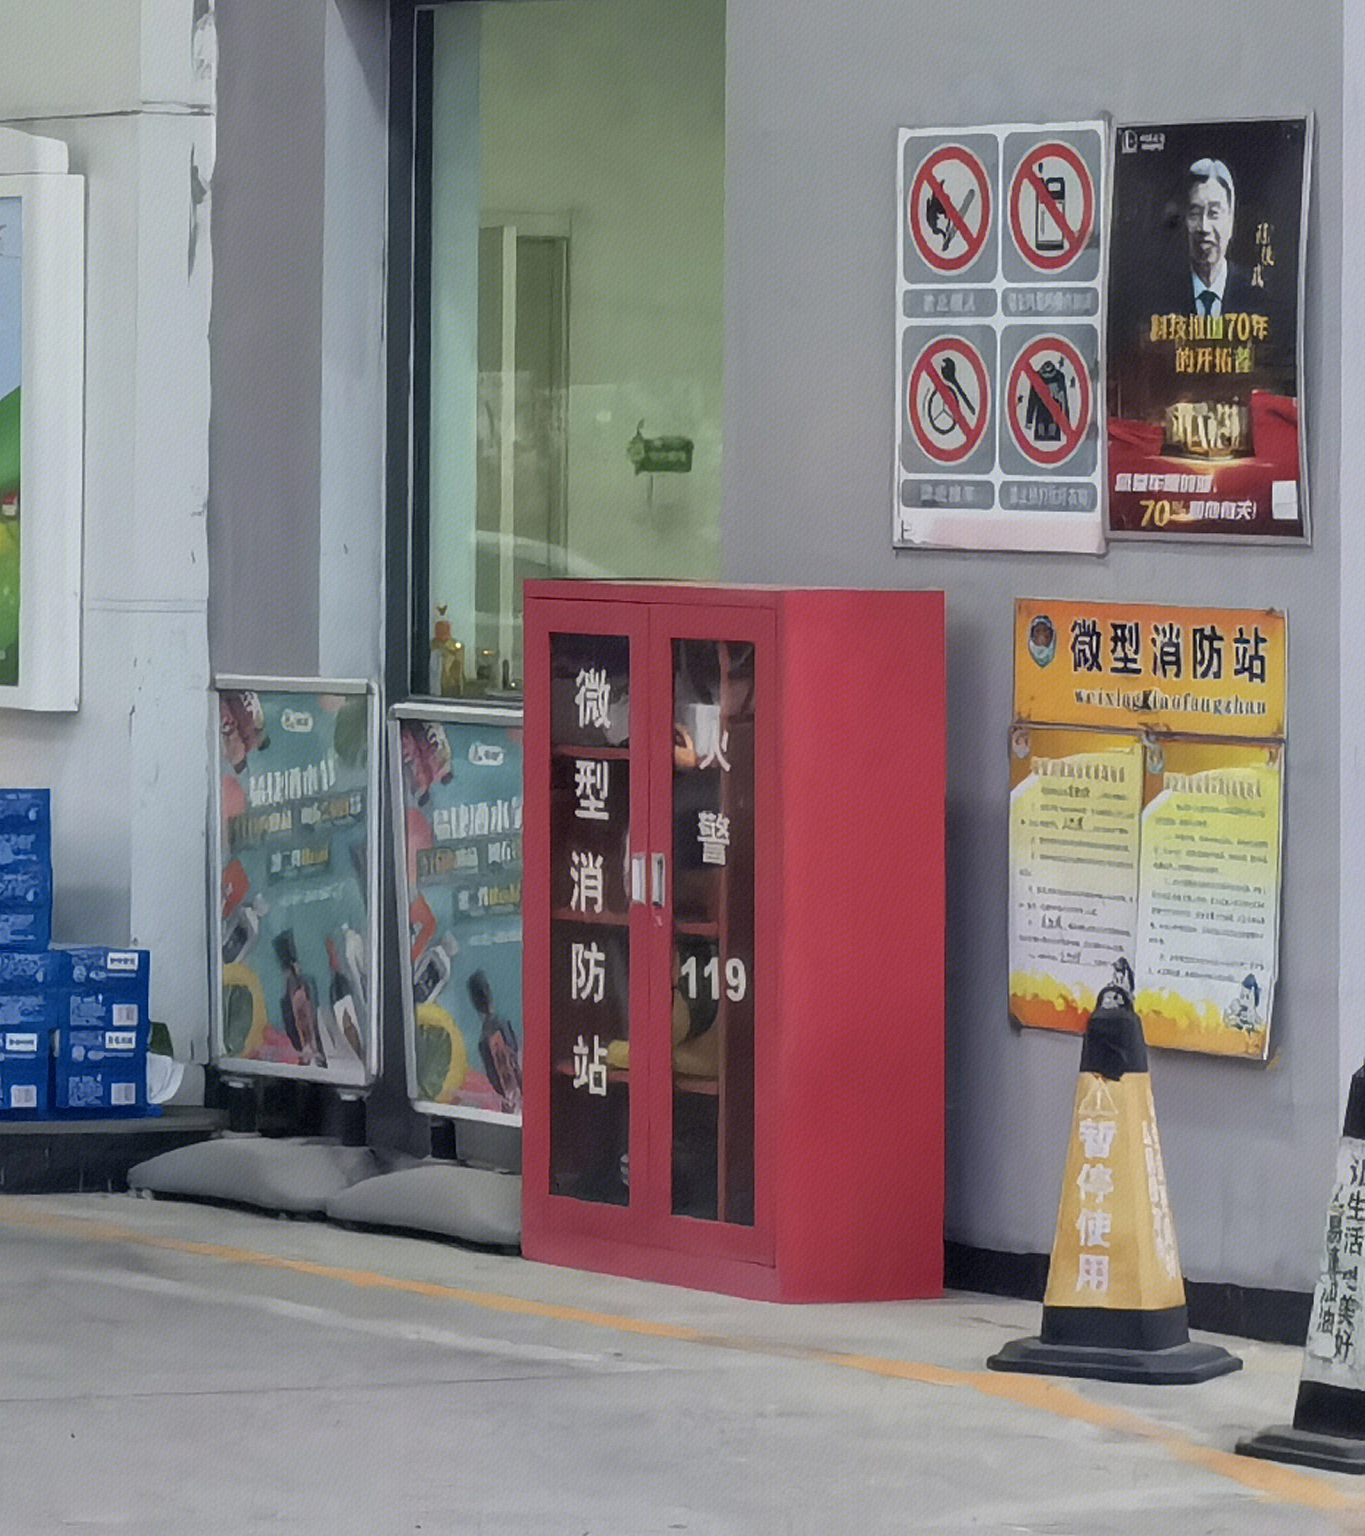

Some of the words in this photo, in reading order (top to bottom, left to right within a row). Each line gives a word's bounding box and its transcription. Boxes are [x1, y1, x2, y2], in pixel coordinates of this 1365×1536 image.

[1070, 618, 1268, 684] 微型消防站
[570, 667, 612, 1097] 微型消防站
[680, 955, 747, 1002] 119
[1075, 1117, 1118, 1293] 暂停使用
